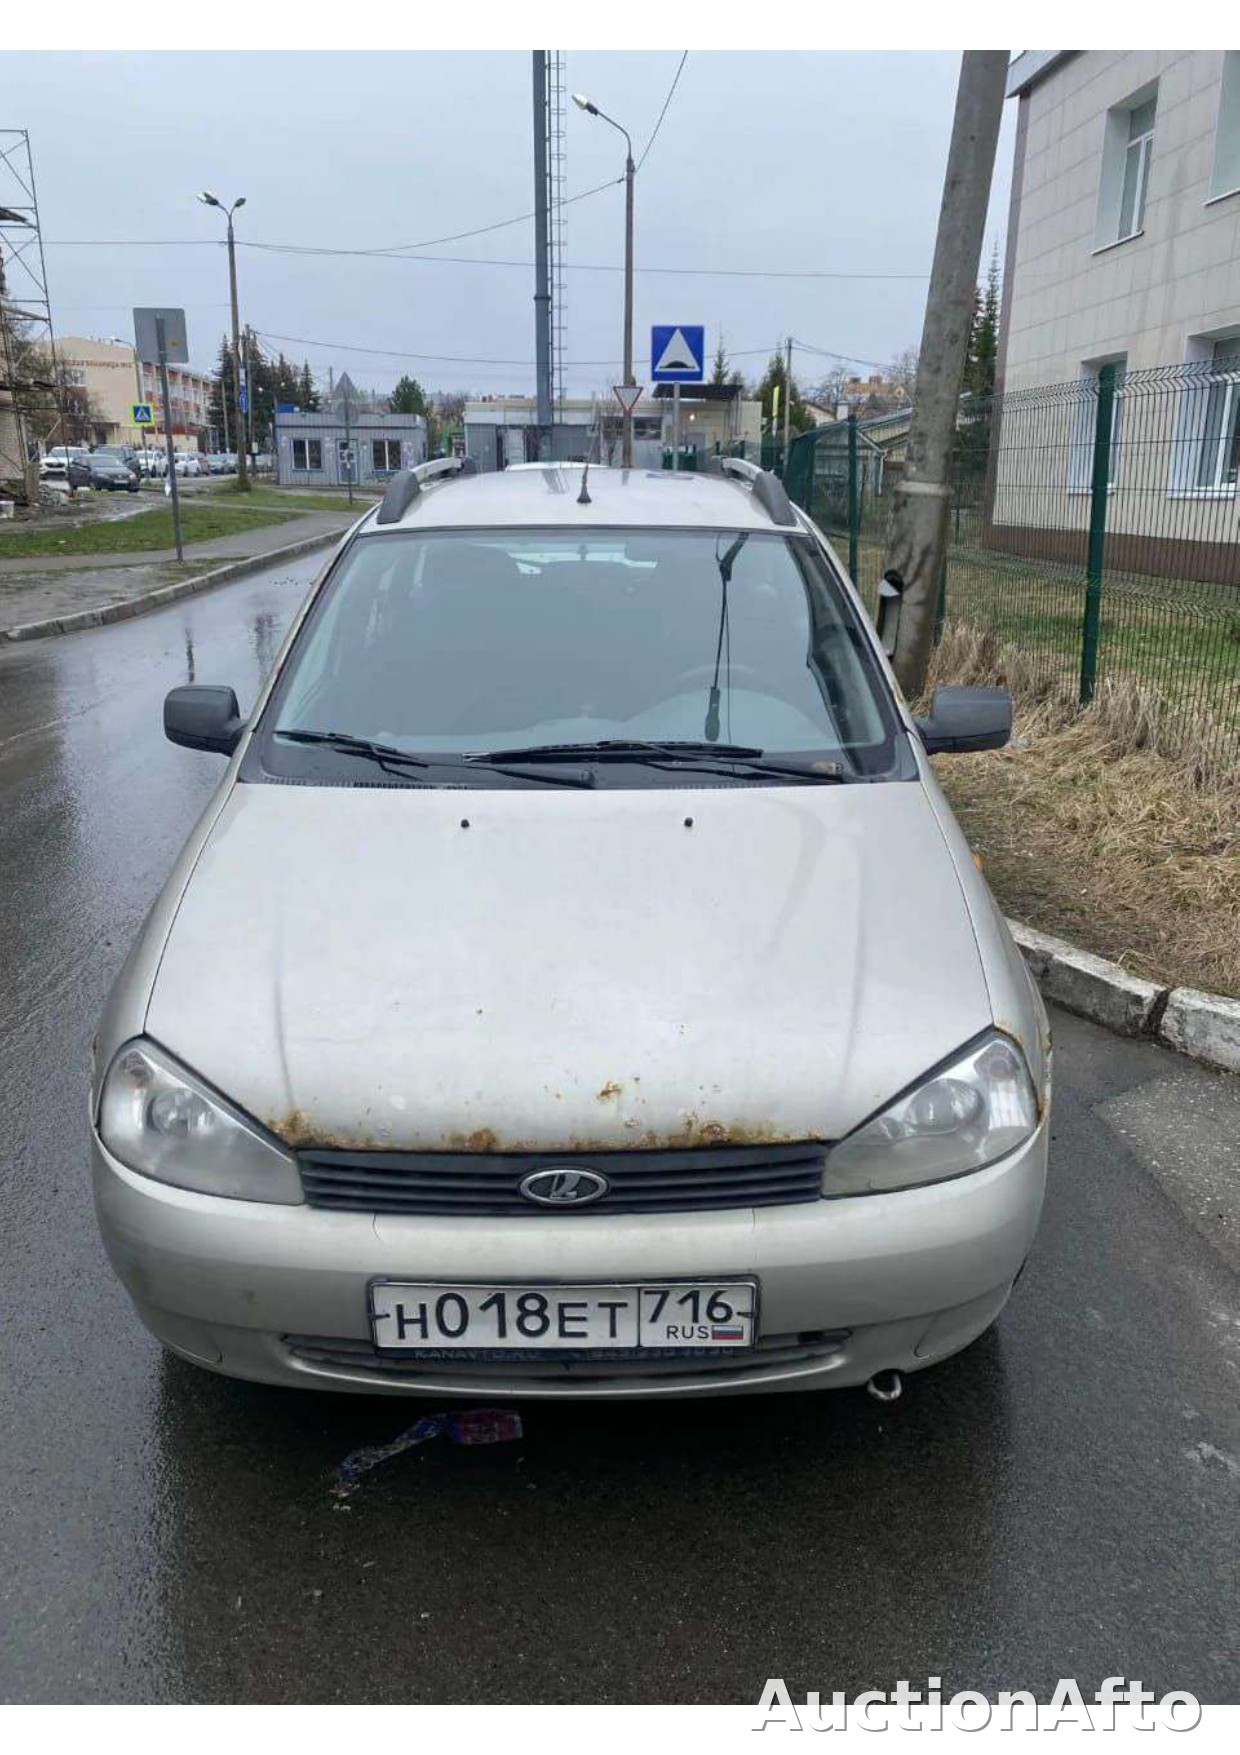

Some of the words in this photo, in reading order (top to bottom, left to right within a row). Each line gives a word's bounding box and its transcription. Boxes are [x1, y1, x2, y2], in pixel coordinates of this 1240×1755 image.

[396, 1291, 629, 1340] Н018ЕТ
[643, 1289, 734, 1324] 716
[666, 1324, 710, 1340] RUS
